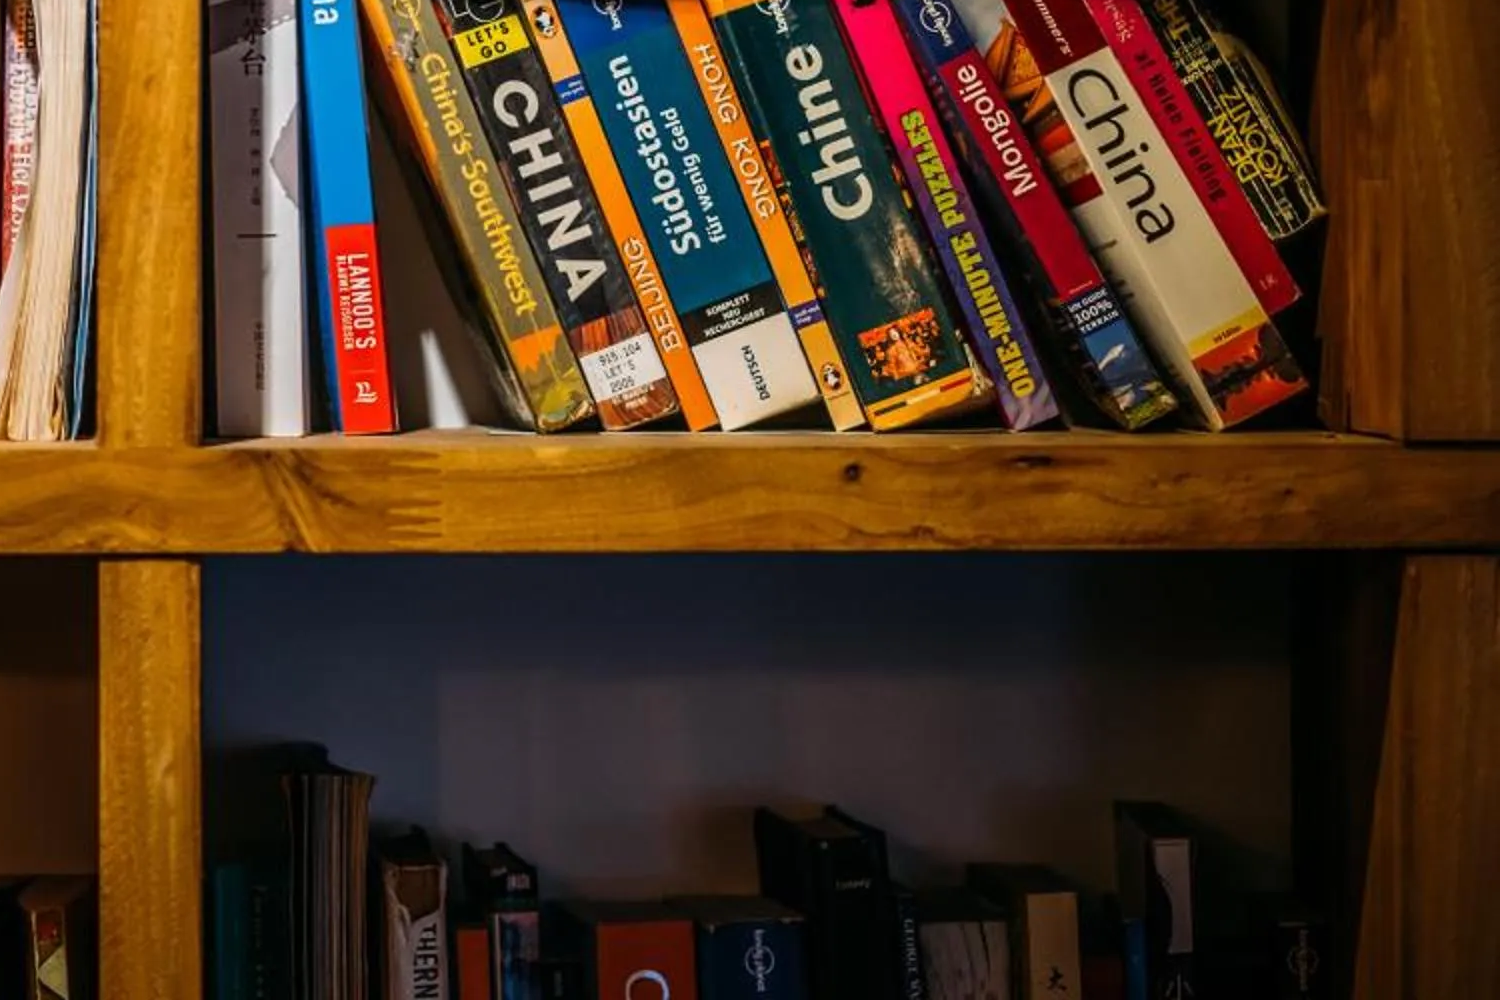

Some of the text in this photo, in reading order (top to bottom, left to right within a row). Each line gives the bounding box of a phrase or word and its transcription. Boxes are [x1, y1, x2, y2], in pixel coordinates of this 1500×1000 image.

[465, 21, 509, 47] LET'S
[478, 39, 508, 59] GO
[419, 51, 540, 315] China's Southwest
[491, 80, 608, 301] CHINA
[607, 55, 701, 257] Südostasien
[659, 104, 729, 244] für wenig Geld
[692, 40, 778, 220] HONG KONG
[783, 44, 876, 223] Chine
[956, 62, 1037, 197] Mongolie
[1066, 68, 1176, 244] China
[1177, 123, 1231, 203] Fielding
[1206, 111, 1261, 184] DEAN
[1220, 89, 1290, 188] KOONTZ
[346, 252, 377, 350] LANNOO'S
[620, 233, 684, 356] BEIJING
[898, 108, 1037, 399] ONE-MINUTE PUZZLES
[1073, 297, 1113, 324] 100%
[739, 343, 770, 401] DEUTSCH
